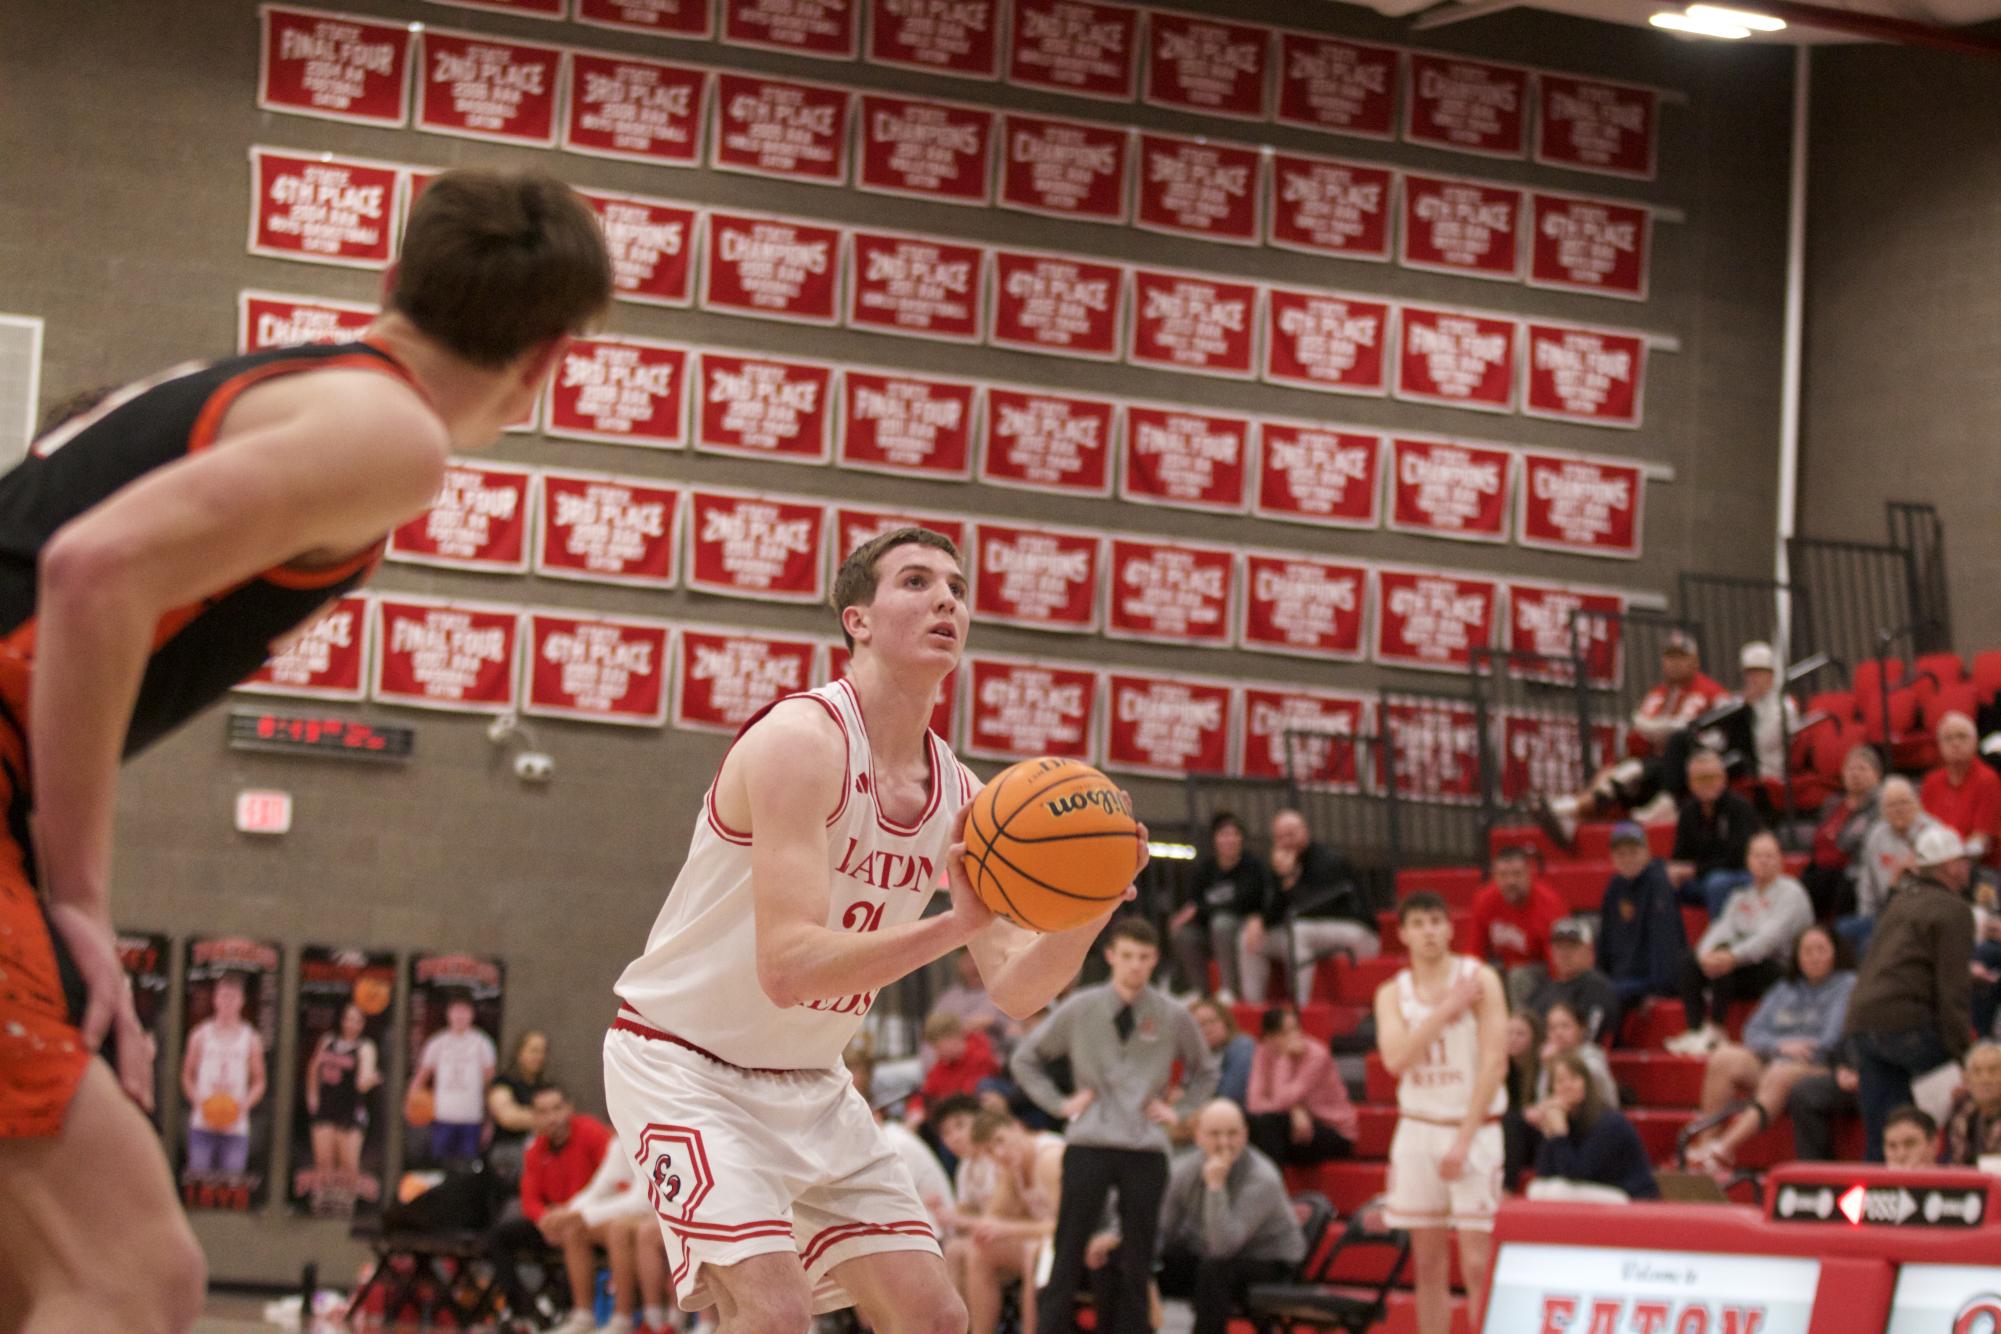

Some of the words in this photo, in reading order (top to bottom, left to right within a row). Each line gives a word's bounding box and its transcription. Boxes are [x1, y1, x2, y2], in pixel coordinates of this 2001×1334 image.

[282, 28, 336, 64] FINAL
[339, 41, 393, 75] FOUR
[434, 51, 476, 83] 2ND
[479, 60, 543, 94] PLACE
[585, 73, 624, 104] 3RD
[627, 81, 690, 116] PLACE
[729, 90, 768, 122] 4TH
[771, 100, 833, 135] PLACE
[873, 111, 979, 154] CHAMPIONS
[1013, 131, 1115, 174] CHAMPIONS
[271, 172, 313, 204] 4TH
[316, 181, 383, 218] PLACE
[606, 220, 682, 254] MPIONS
[719, 228, 827, 273] CHAMPIONS
[866, 250, 904, 281] 2ND
[908, 258, 968, 292] PLACE
[1006, 269, 1044, 300] 4TH
[1047, 277, 1107, 310] PLACE
[1144, 289, 1182, 318] 2ND
[1185, 296, 1244, 331] PLACE
[562, 353, 607, 388] 3RD
[609, 363, 672, 397] PLACE
[710, 370, 750, 402] 2ND
[754, 379, 817, 412] PLACE
[855, 387, 907, 420] FINAL
[911, 398, 961, 429] FOUR
[997, 405, 1036, 435] 2ND
[1039, 414, 1099, 448] PLACE
[1271, 439, 1306, 469] 2ND
[1309, 447, 1366, 479] PLACE
[1401, 452, 1499, 494] CHAMPIONS
[463, 488, 517, 521] FOUR
[1533, 467, 1628, 509] CHAMPIONS
[555, 492, 595, 525] 3RD
[598, 502, 663, 536] PLACE
[702, 509, 743, 540] 2ND
[747, 518, 810, 553] PLACE
[985, 540, 1088, 582] CHAMPIONS
[1255, 569, 1356, 611] CHAMPIONS
[391, 618, 447, 652] FINAL
[451, 629, 504, 661] FOUR
[543, 633, 584, 663] 4TH
[588, 641, 651, 675] PLACE
[693, 646, 731, 679] 2ND
[735, 656, 799, 687] PLACE
[981, 677, 1019, 706] 4TH
[1022, 684, 1081, 717] PLACE
[1118, 689, 1220, 730] CHAMPIONS
[1251, 703, 1351, 743] CHAMPIONS
[1047, 789, 1131, 817] ilson
[800, 992, 871, 1016] DS
[1865, 1189, 1899, 1221] OSS
[1540, 1295, 1767, 1334] EATON
